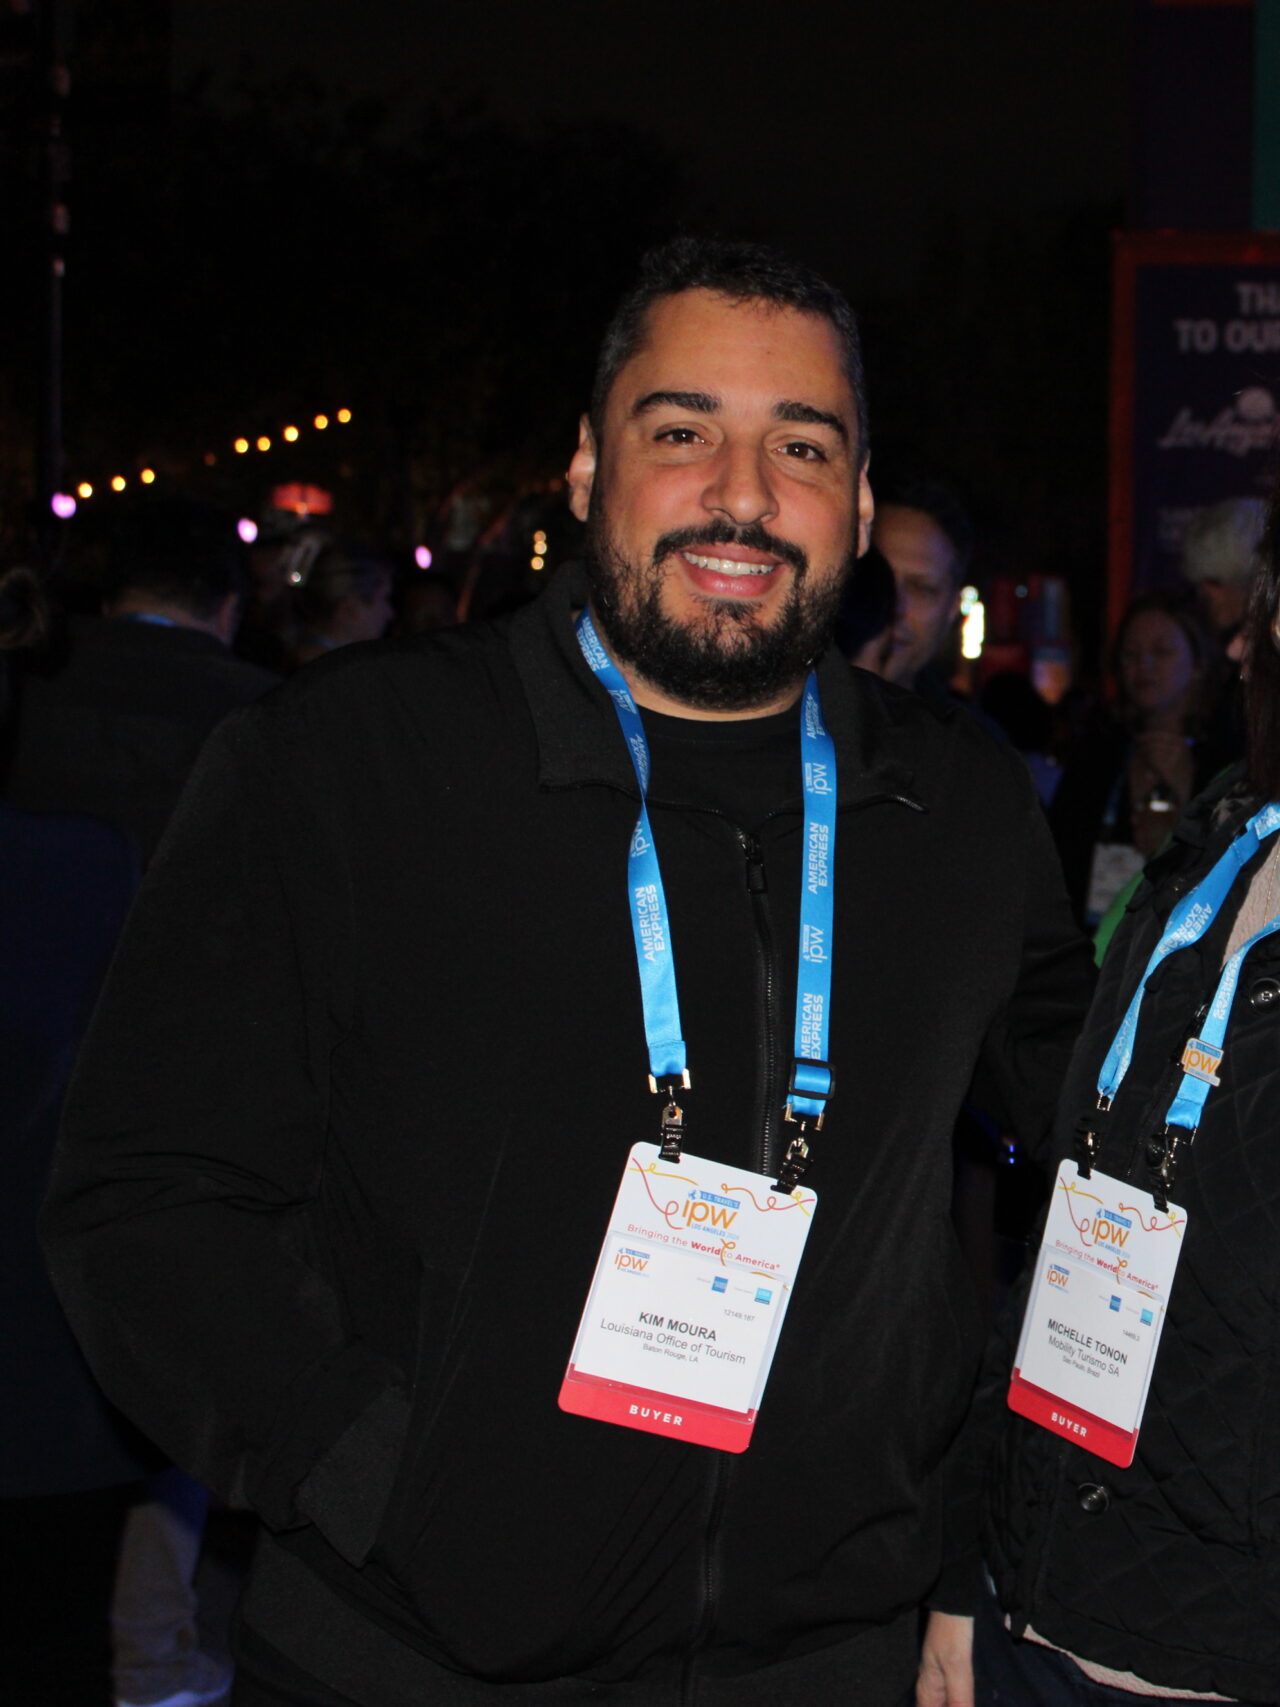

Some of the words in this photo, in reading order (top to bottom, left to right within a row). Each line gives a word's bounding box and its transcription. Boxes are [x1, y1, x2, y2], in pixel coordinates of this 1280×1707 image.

[1173, 318, 1217, 352] TO
[582, 616, 610, 669] AMERICAN
[813, 763, 832, 795] ipw
[807, 822, 819, 895] AMERICAN
[818, 824, 829, 888] EXPRESS
[634, 886, 657, 962] AMERICAN
[645, 884, 666, 951] EXPRESS
[810, 926, 828, 964] ipw
[801, 992, 813, 1058] MERICAN
[811, 994, 823, 1060] EXPRESS
[1184, 1048, 1219, 1074] ipw
[682, 1200, 738, 1229] ipw
[627, 1224, 669, 1243] Bringing
[672, 1237, 688, 1247] the
[691, 1241, 722, 1256] World
[1092, 1218, 1130, 1247] ipw
[614, 1253, 649, 1272] ipw
[1056, 1240, 1083, 1259] Bringing
[1084, 1252, 1095, 1262] the
[1097, 1258, 1120, 1273] World
[1047, 1270, 1068, 1286] ipw
[600, 1318, 653, 1341] Louisiana
[656, 1333, 688, 1350] Office
[691, 1343, 702, 1353] of
[705, 1344, 747, 1365] Tourism
[638, 1311, 664, 1328] KIM
[666, 1319, 718, 1341] MOURA
[1047, 1318, 1093, 1348] MICHELLE
[1095, 1340, 1128, 1365] TONON
[689, 1354, 699, 1363] LA
[1048, 1335, 1076, 1357] Mobility
[1078, 1348, 1107, 1371] Turismo
[1108, 1363, 1120, 1377] SA
[629, 1404, 683, 1426] BUYER
[1051, 1412, 1087, 1437] BUYER
